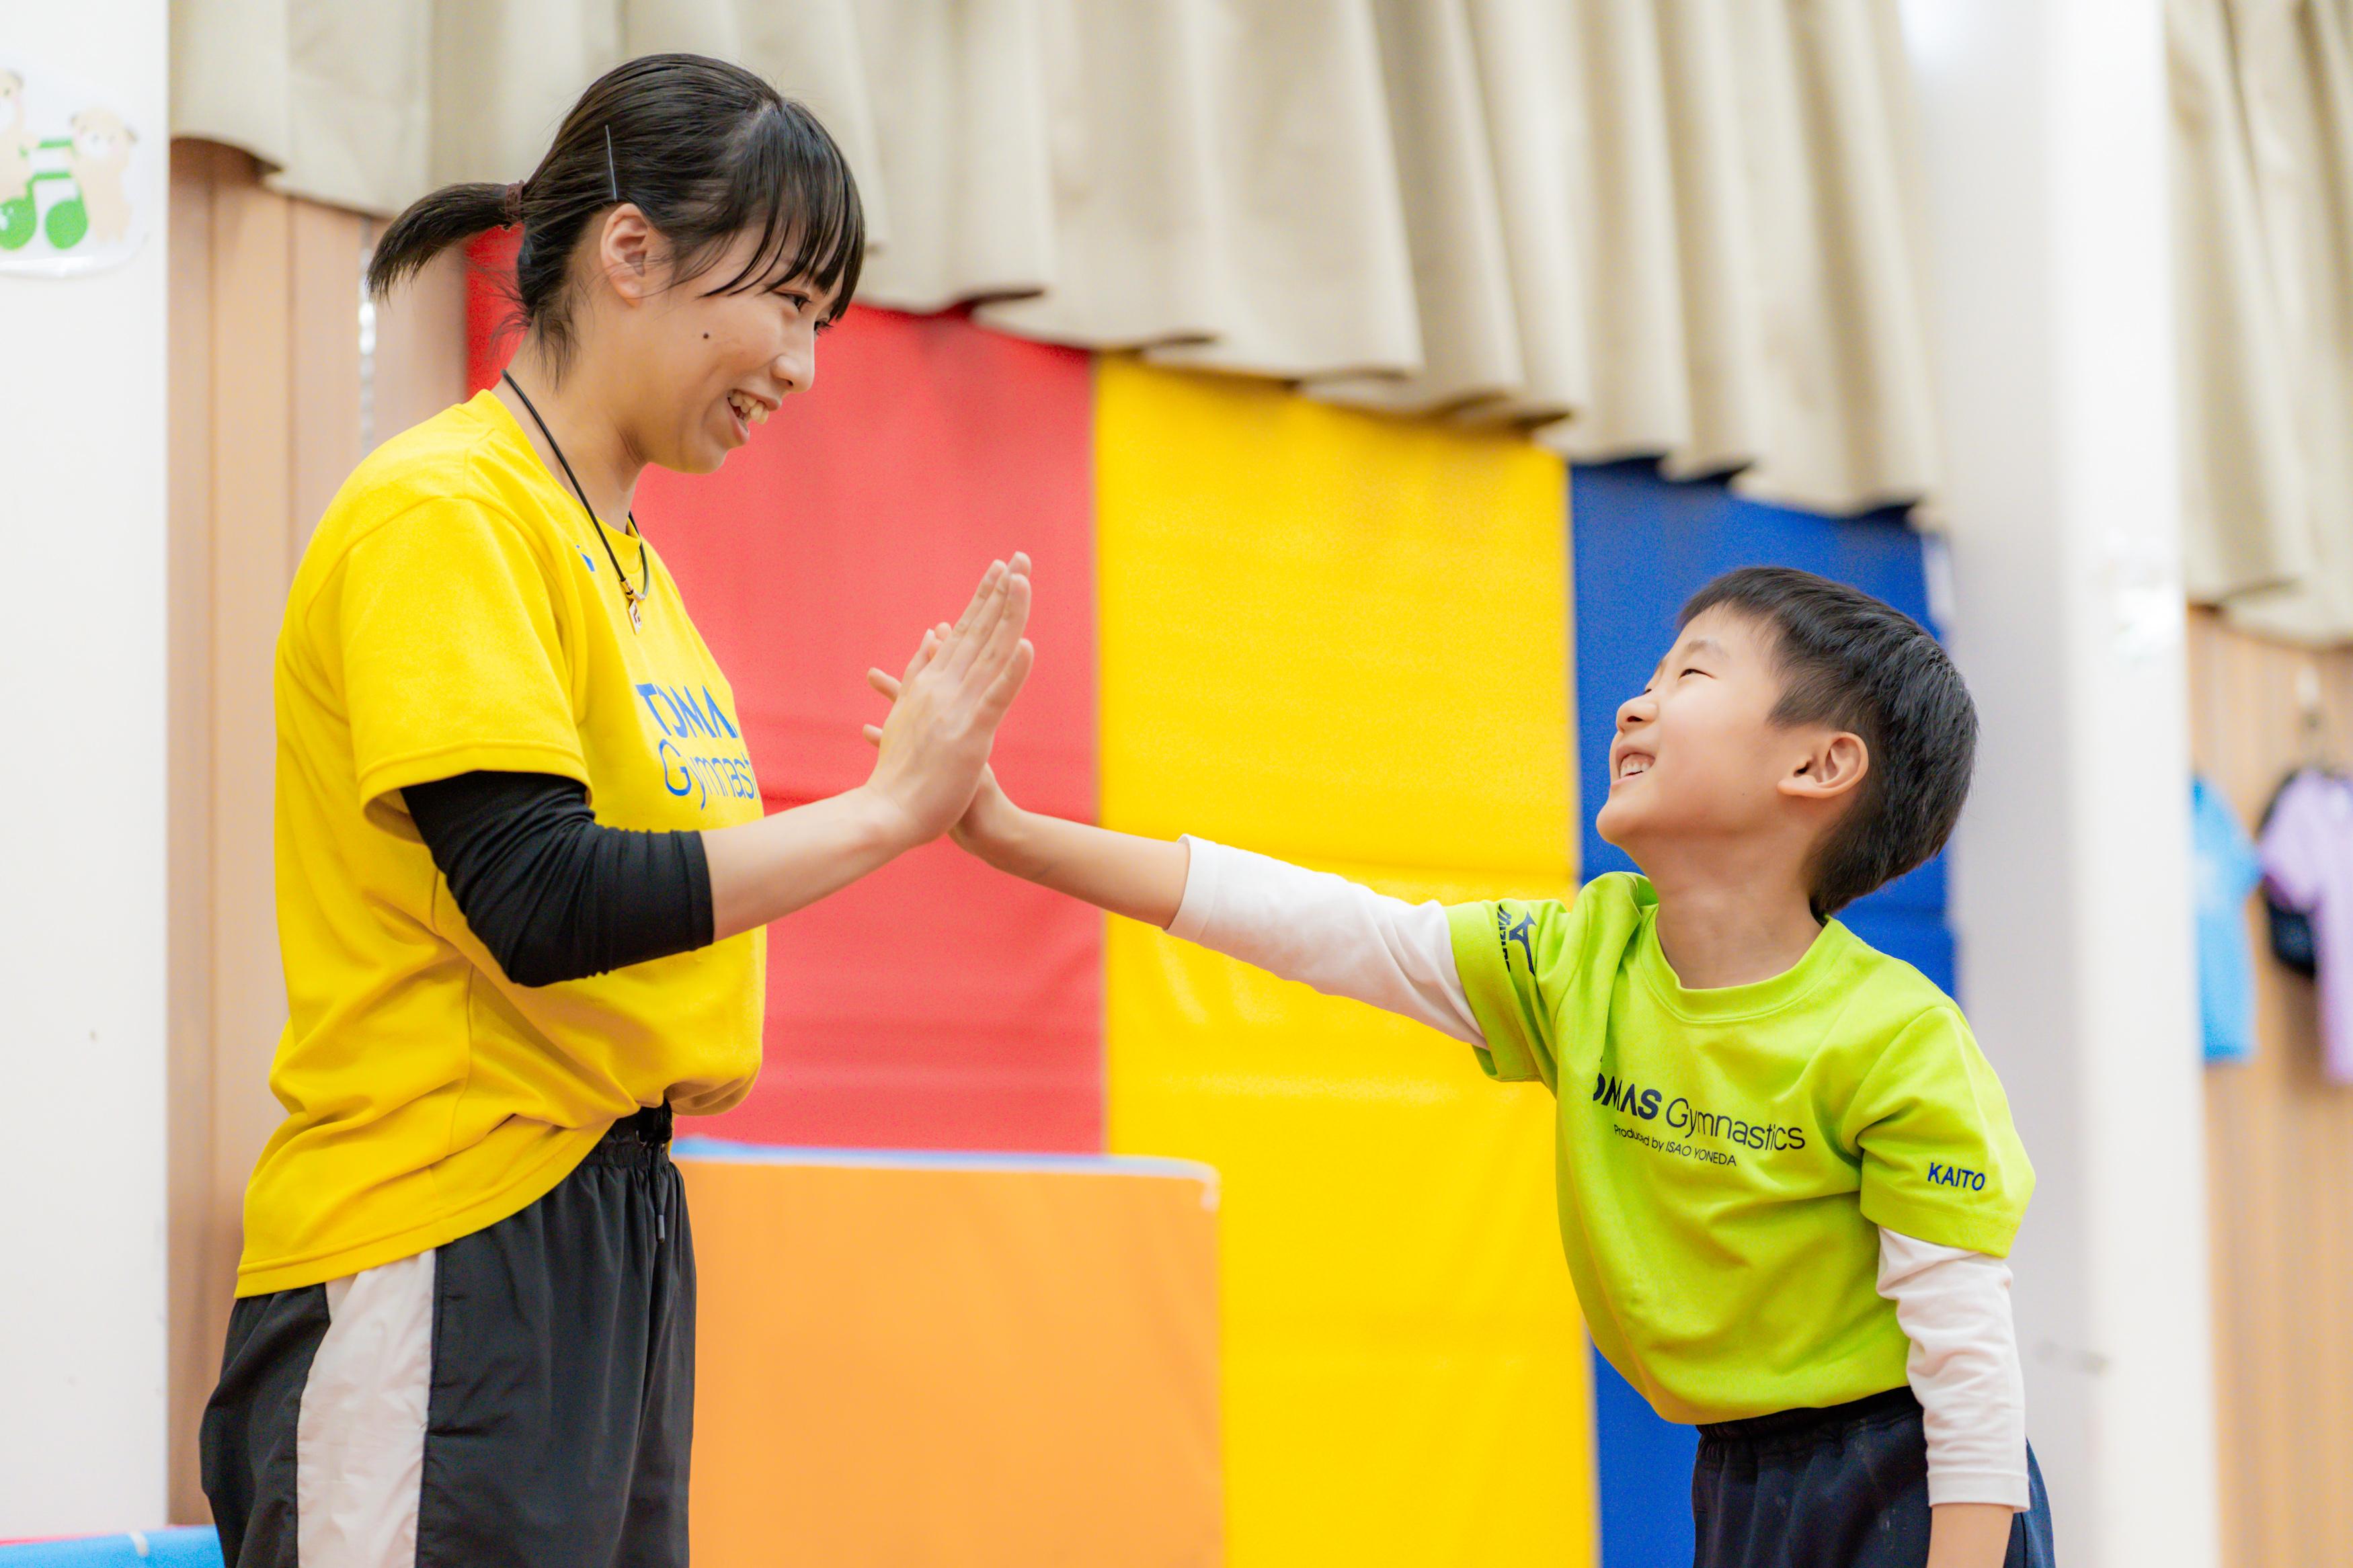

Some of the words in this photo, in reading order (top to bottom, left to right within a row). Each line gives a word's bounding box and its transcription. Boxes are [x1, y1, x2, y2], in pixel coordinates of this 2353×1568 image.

[1613, 1124, 1650, 1147] Produced
[1651, 1137, 1665, 1153] by
[1665, 1141, 1692, 1157] ISAO
[1693, 1147, 1737, 1167] YONEDA
[1665, 1098, 1806, 1151] Gymnastics
[1927, 1162, 1985, 1191] KAITO
